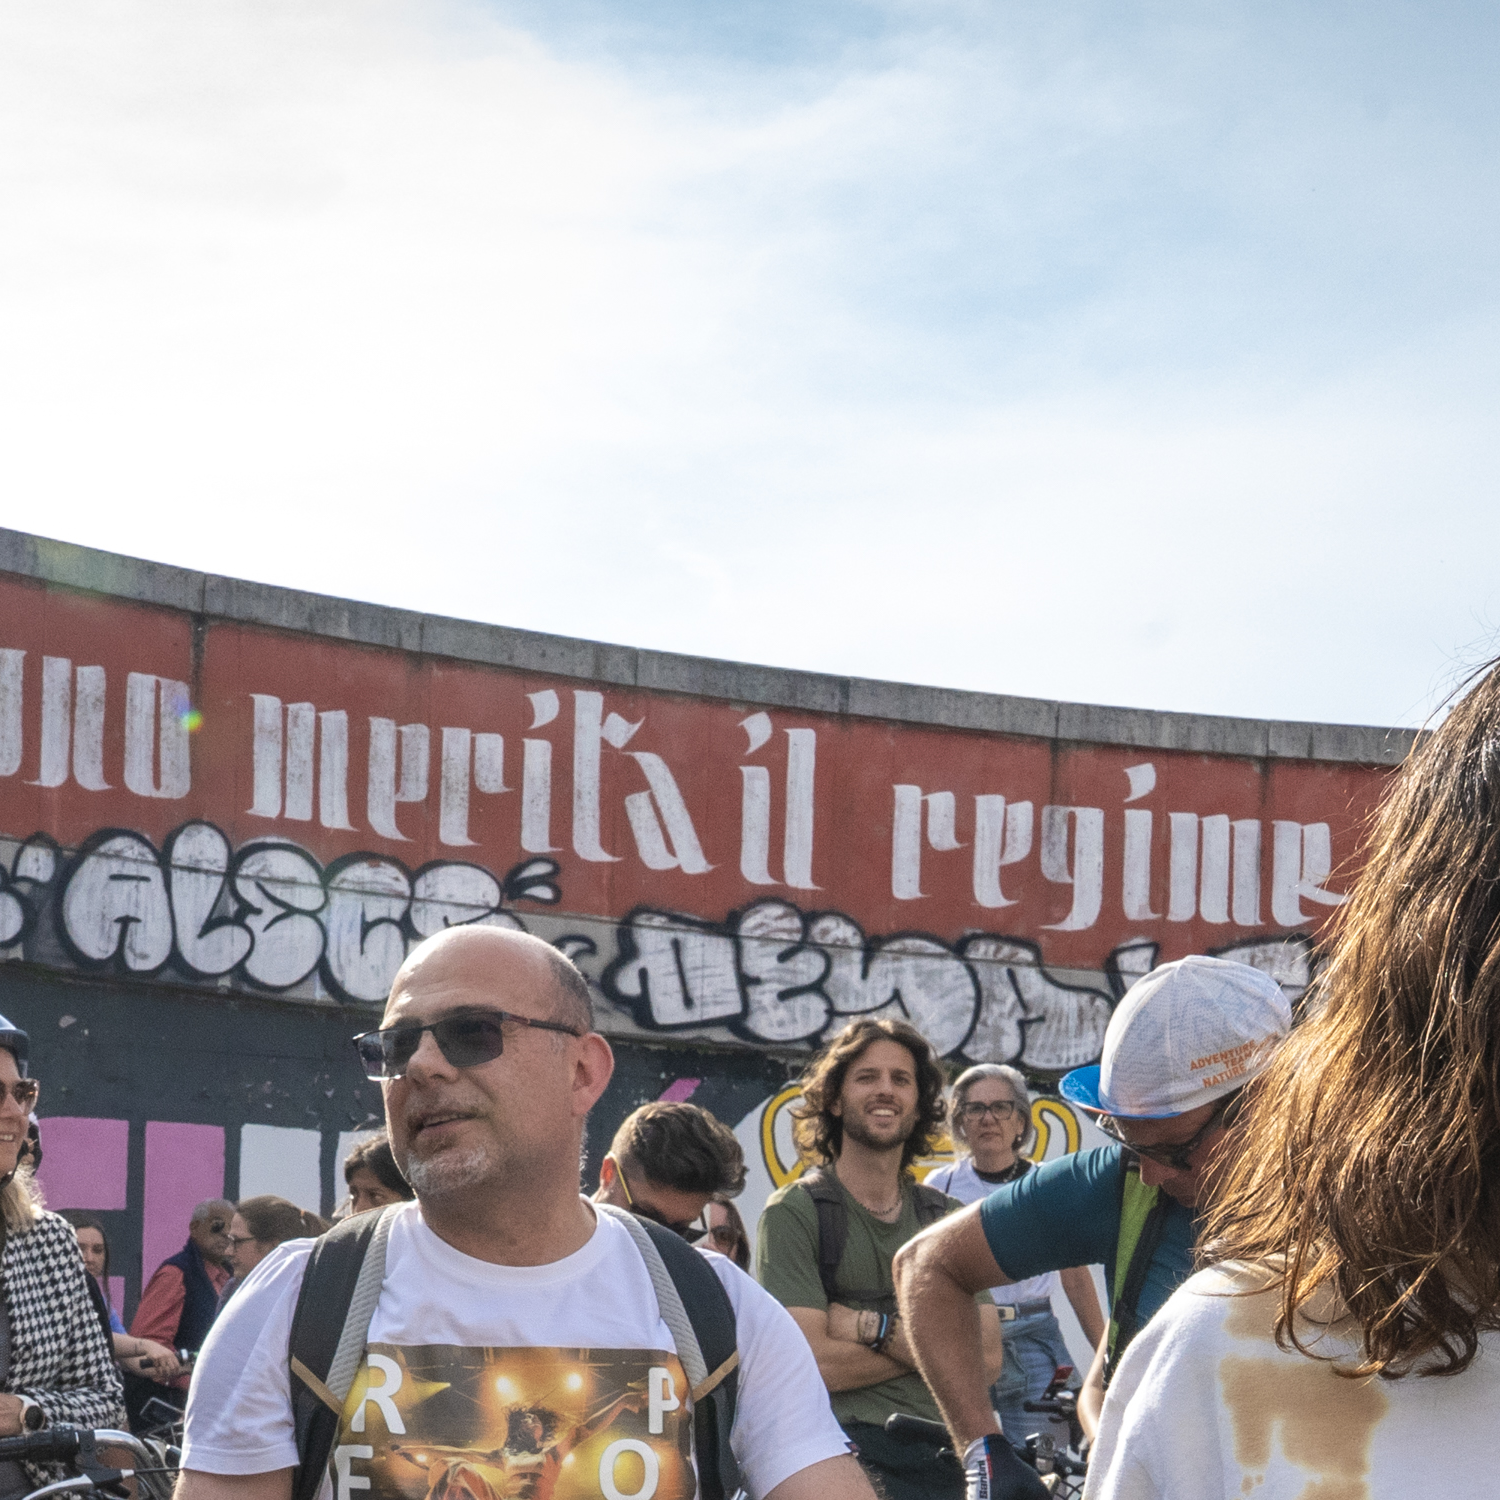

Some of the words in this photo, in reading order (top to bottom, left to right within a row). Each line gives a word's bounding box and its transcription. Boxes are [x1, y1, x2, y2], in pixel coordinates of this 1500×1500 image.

[738, 710, 825, 890] il
[891, 763, 1350, 932] regime
[1190, 1039, 1255, 1071] ADVENTURE
